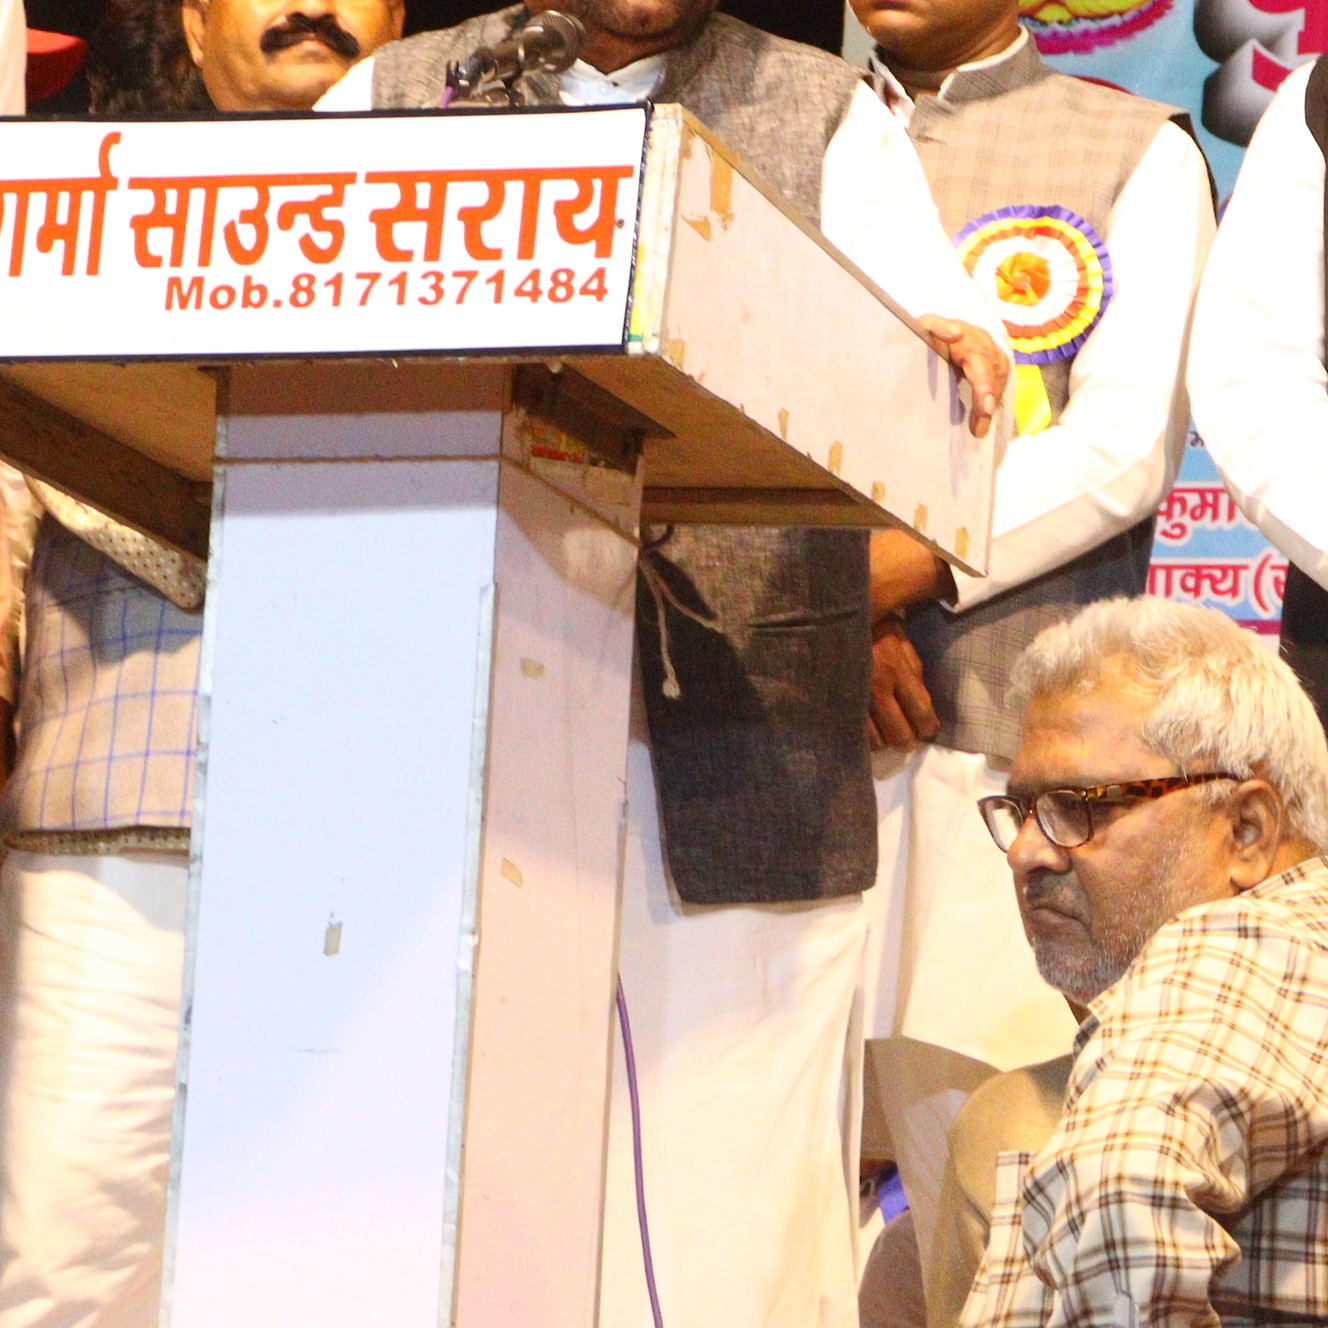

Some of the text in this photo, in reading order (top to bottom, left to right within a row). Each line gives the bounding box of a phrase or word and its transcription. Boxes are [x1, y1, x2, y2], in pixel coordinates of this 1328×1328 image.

[128, 172, 357, 268] साउन्ड
[365, 165, 634, 262] सराय
[164, 267, 609, 311] Mob.8171371484
